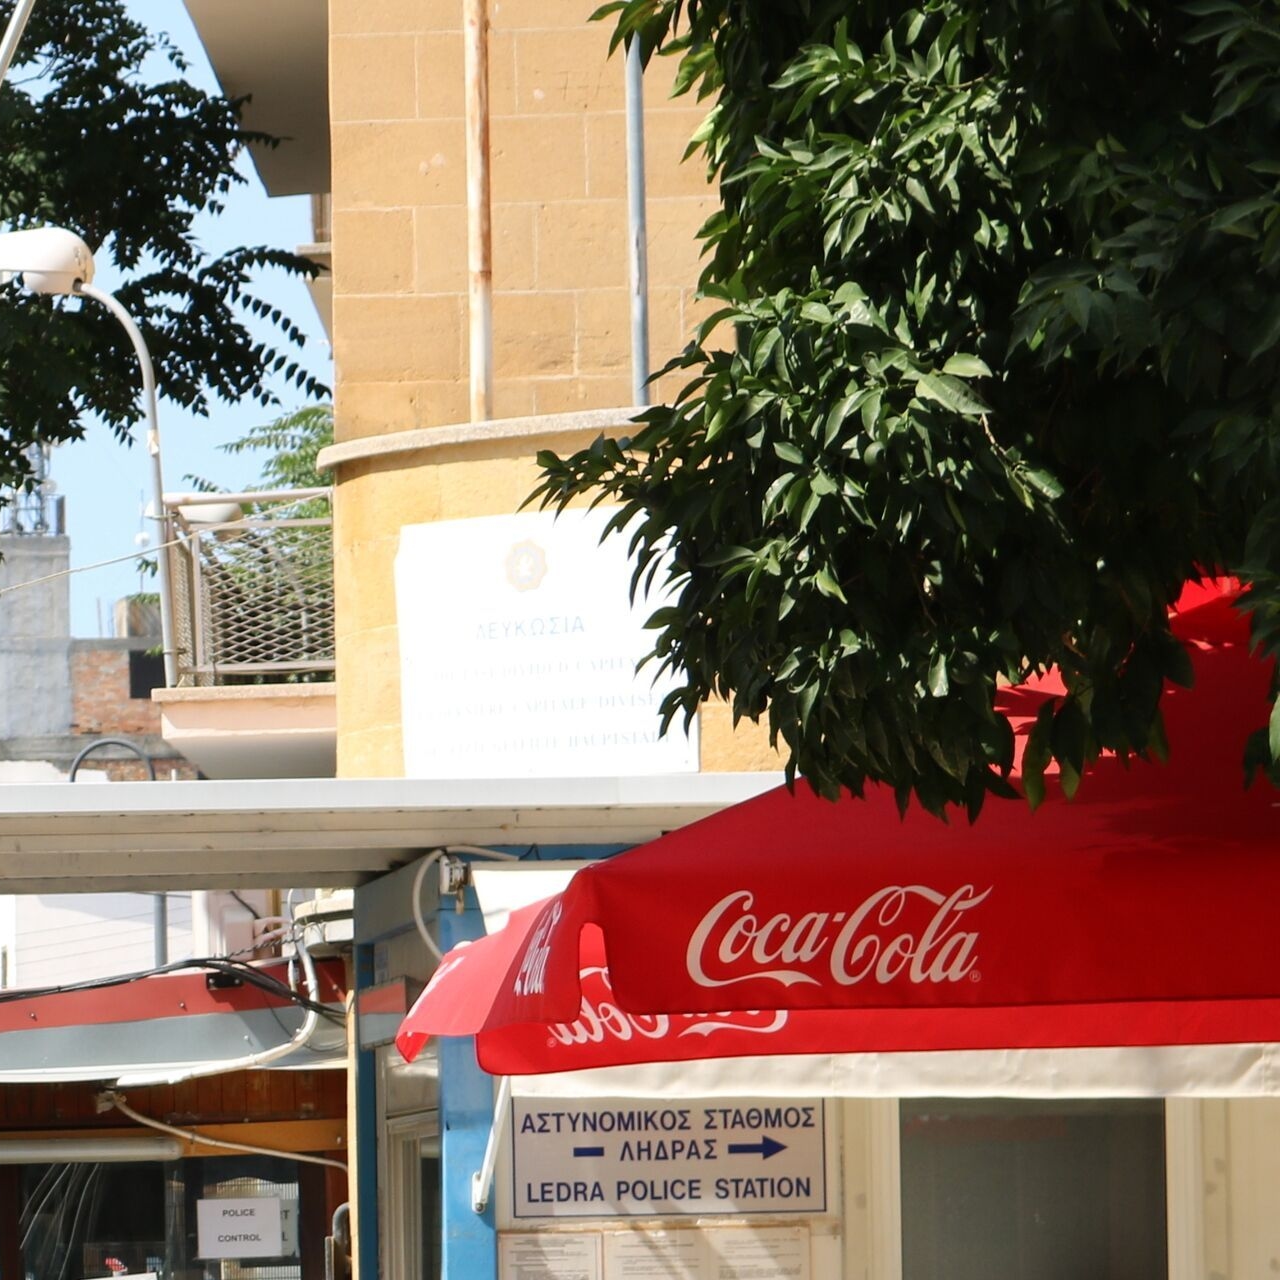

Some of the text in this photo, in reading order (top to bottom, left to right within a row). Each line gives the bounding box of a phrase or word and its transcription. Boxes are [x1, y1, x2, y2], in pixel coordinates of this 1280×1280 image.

[686, 884, 993, 987] Coca-Cola
[520, 1107, 816, 1133] ΑΣΤΥΝΟΜΙΚΟΣ ΣΤΑΘΜΟΣ
[619, 1139, 718, 1161] ΛΗΔΡΑΣ
[527, 1177, 811, 1203] LEDRA POLICE STATION
[222, 1208, 255, 1217] POLICE
[217, 1233, 262, 1242] CONTROL
